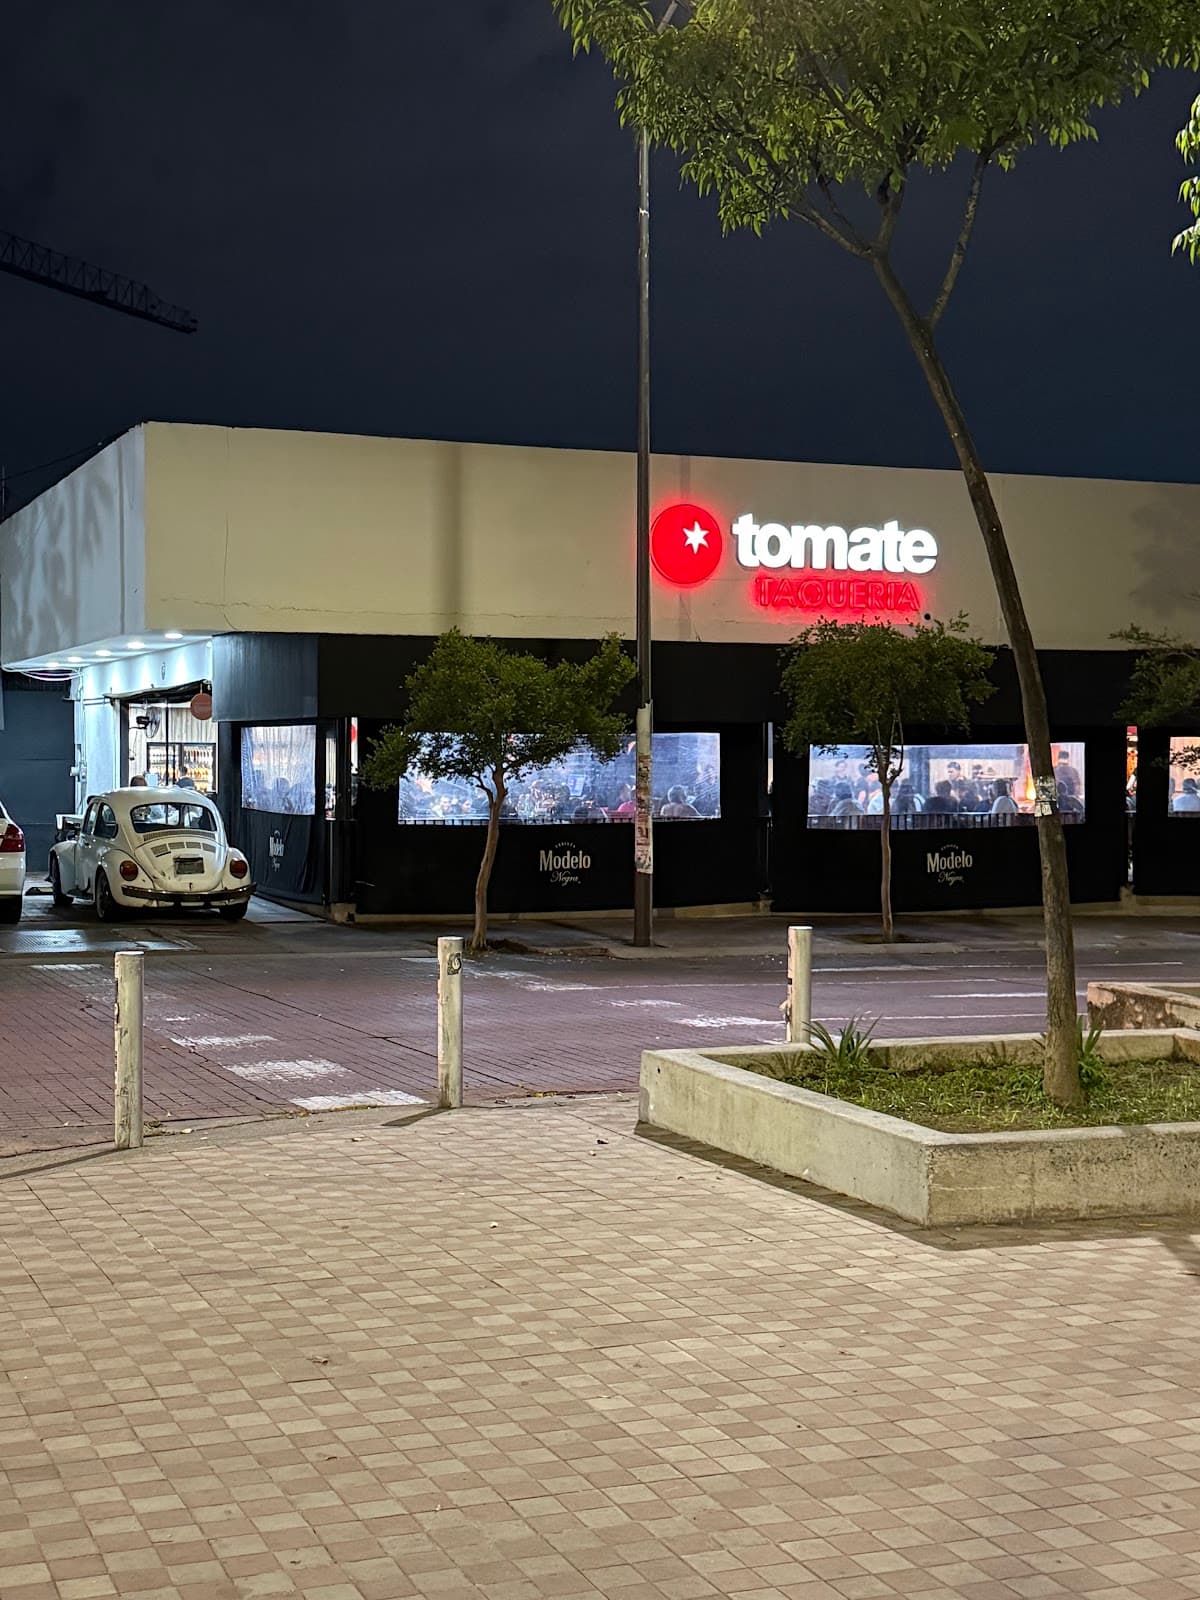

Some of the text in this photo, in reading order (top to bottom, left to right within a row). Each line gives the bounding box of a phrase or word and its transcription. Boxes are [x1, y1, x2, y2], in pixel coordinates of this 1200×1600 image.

[732, 513, 938, 574] tomate
[755, 577, 920, 611] TAQUERIA
[539, 849, 591, 872] Modelo
[926, 850, 973, 873] Modelo
